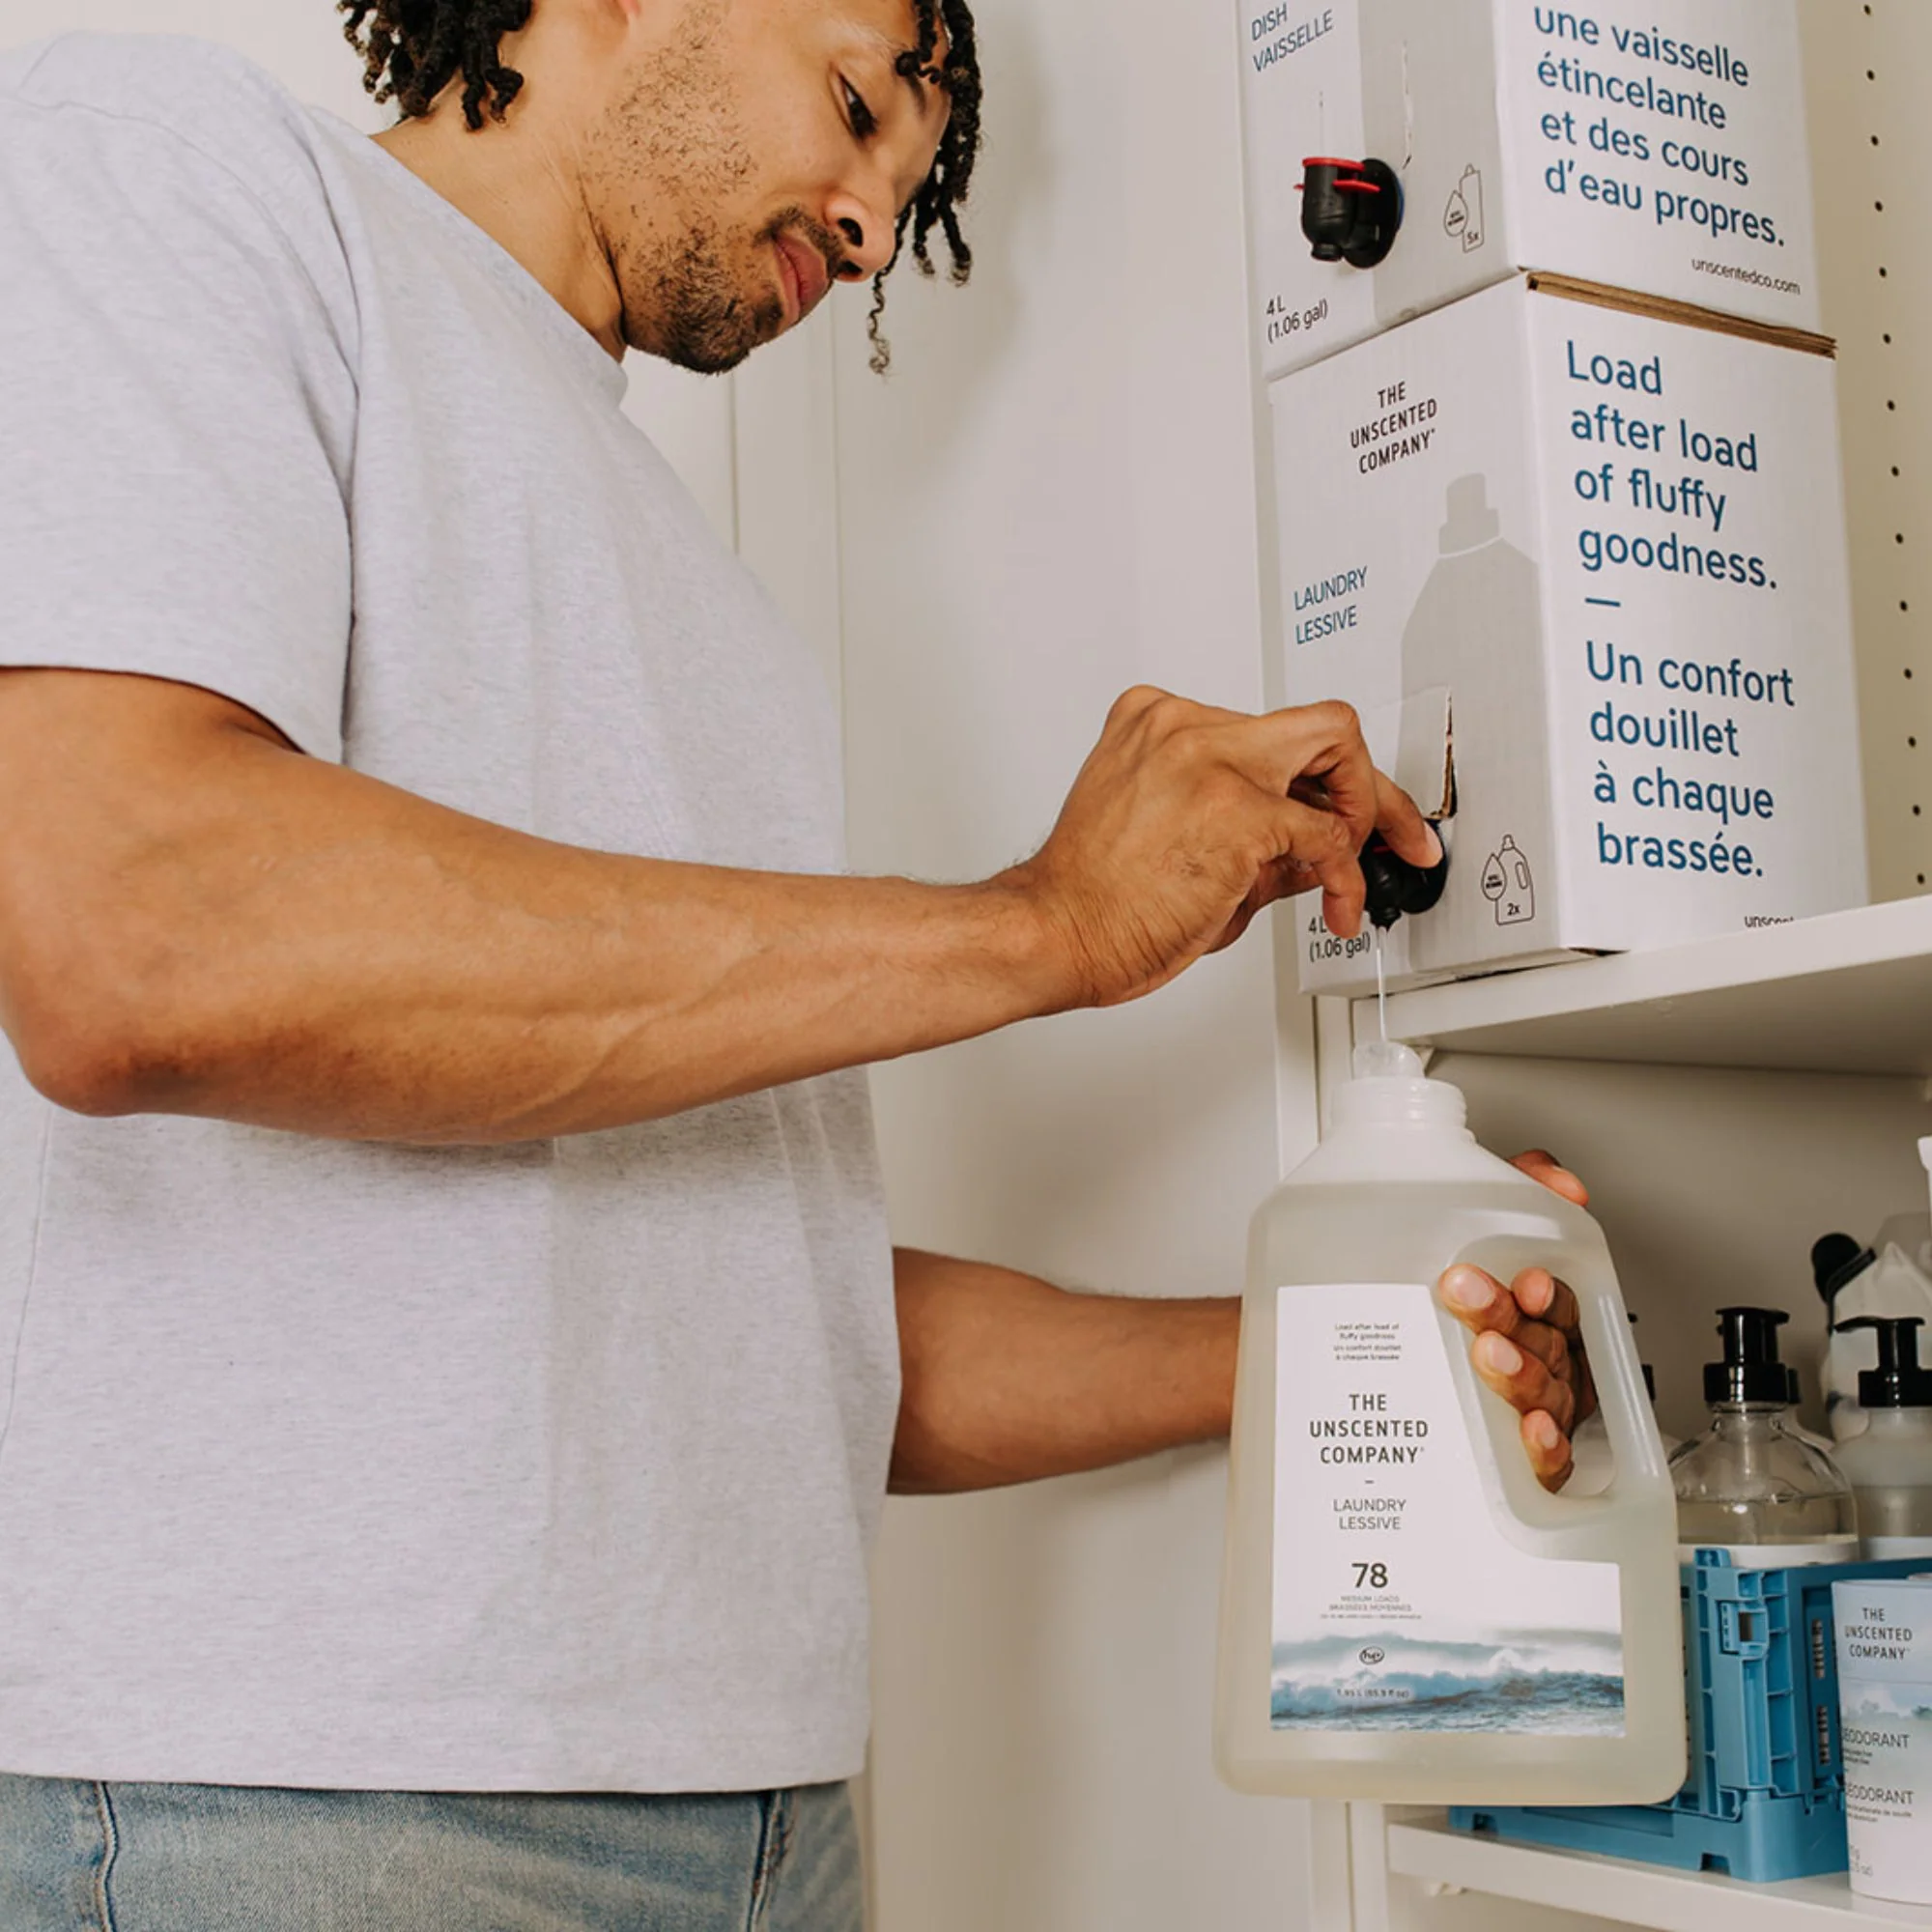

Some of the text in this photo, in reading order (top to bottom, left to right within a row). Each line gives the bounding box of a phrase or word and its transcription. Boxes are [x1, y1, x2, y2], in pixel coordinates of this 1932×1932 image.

[1252, 2, 1287, 42] DISH
[1253, 9, 1333, 72] VAISSELLE
[1534, 6, 1749, 87] une vaisselle
[1537, 50, 1726, 129] étincelante
[1541, 111, 1749, 187] et des cours
[1545, 157, 1785, 247] d'eau propres.
[1691, 258, 1801, 296] unscentedco.com
[1266, 295, 1287, 316] 4 L
[1267, 298, 1328, 344] (1.06 gal)
[1567, 339, 1662, 396] Load
[1378, 381, 1406, 409] THE
[1350, 398, 1438, 449] UNSCENTED
[1571, 403, 1758, 472] after load
[1358, 428, 1435, 474] COMPANY
[1575, 463, 1726, 532] of fluffy
[1578, 528, 1776, 589] goodness.
[1293, 565, 1369, 611] LAUNDRY
[1295, 605, 1357, 645] LESSIVE
[1585, 640, 1795, 707] Un confort
[1590, 700, 1740, 757] douillet
[1594, 759, 1774, 825] à chaque
[1598, 821, 1764, 878] brassée.
[1309, 916, 1327, 935] 4 L
[1507, 902, 1520, 916] 2x
[1310, 931, 1371, 962] (1.06 gal)
[1349, 1393, 1387, 1411] THE
[1309, 1419, 1429, 1438] UNSCENTED
[1320, 1445, 1424, 1464] COMPANY
[1333, 1498, 1406, 1512] LAUNDRY
[1339, 1517, 1402, 1530] LESSIVE
[1351, 1562, 1389, 1588] 78
[1844, 1625, 1913, 1641] UNSCENTED
[1862, 1606, 1886, 1621] THE
[1849, 1644, 1906, 1660] COMPANY
[1842, 1727, 1910, 1748] EODORANT
